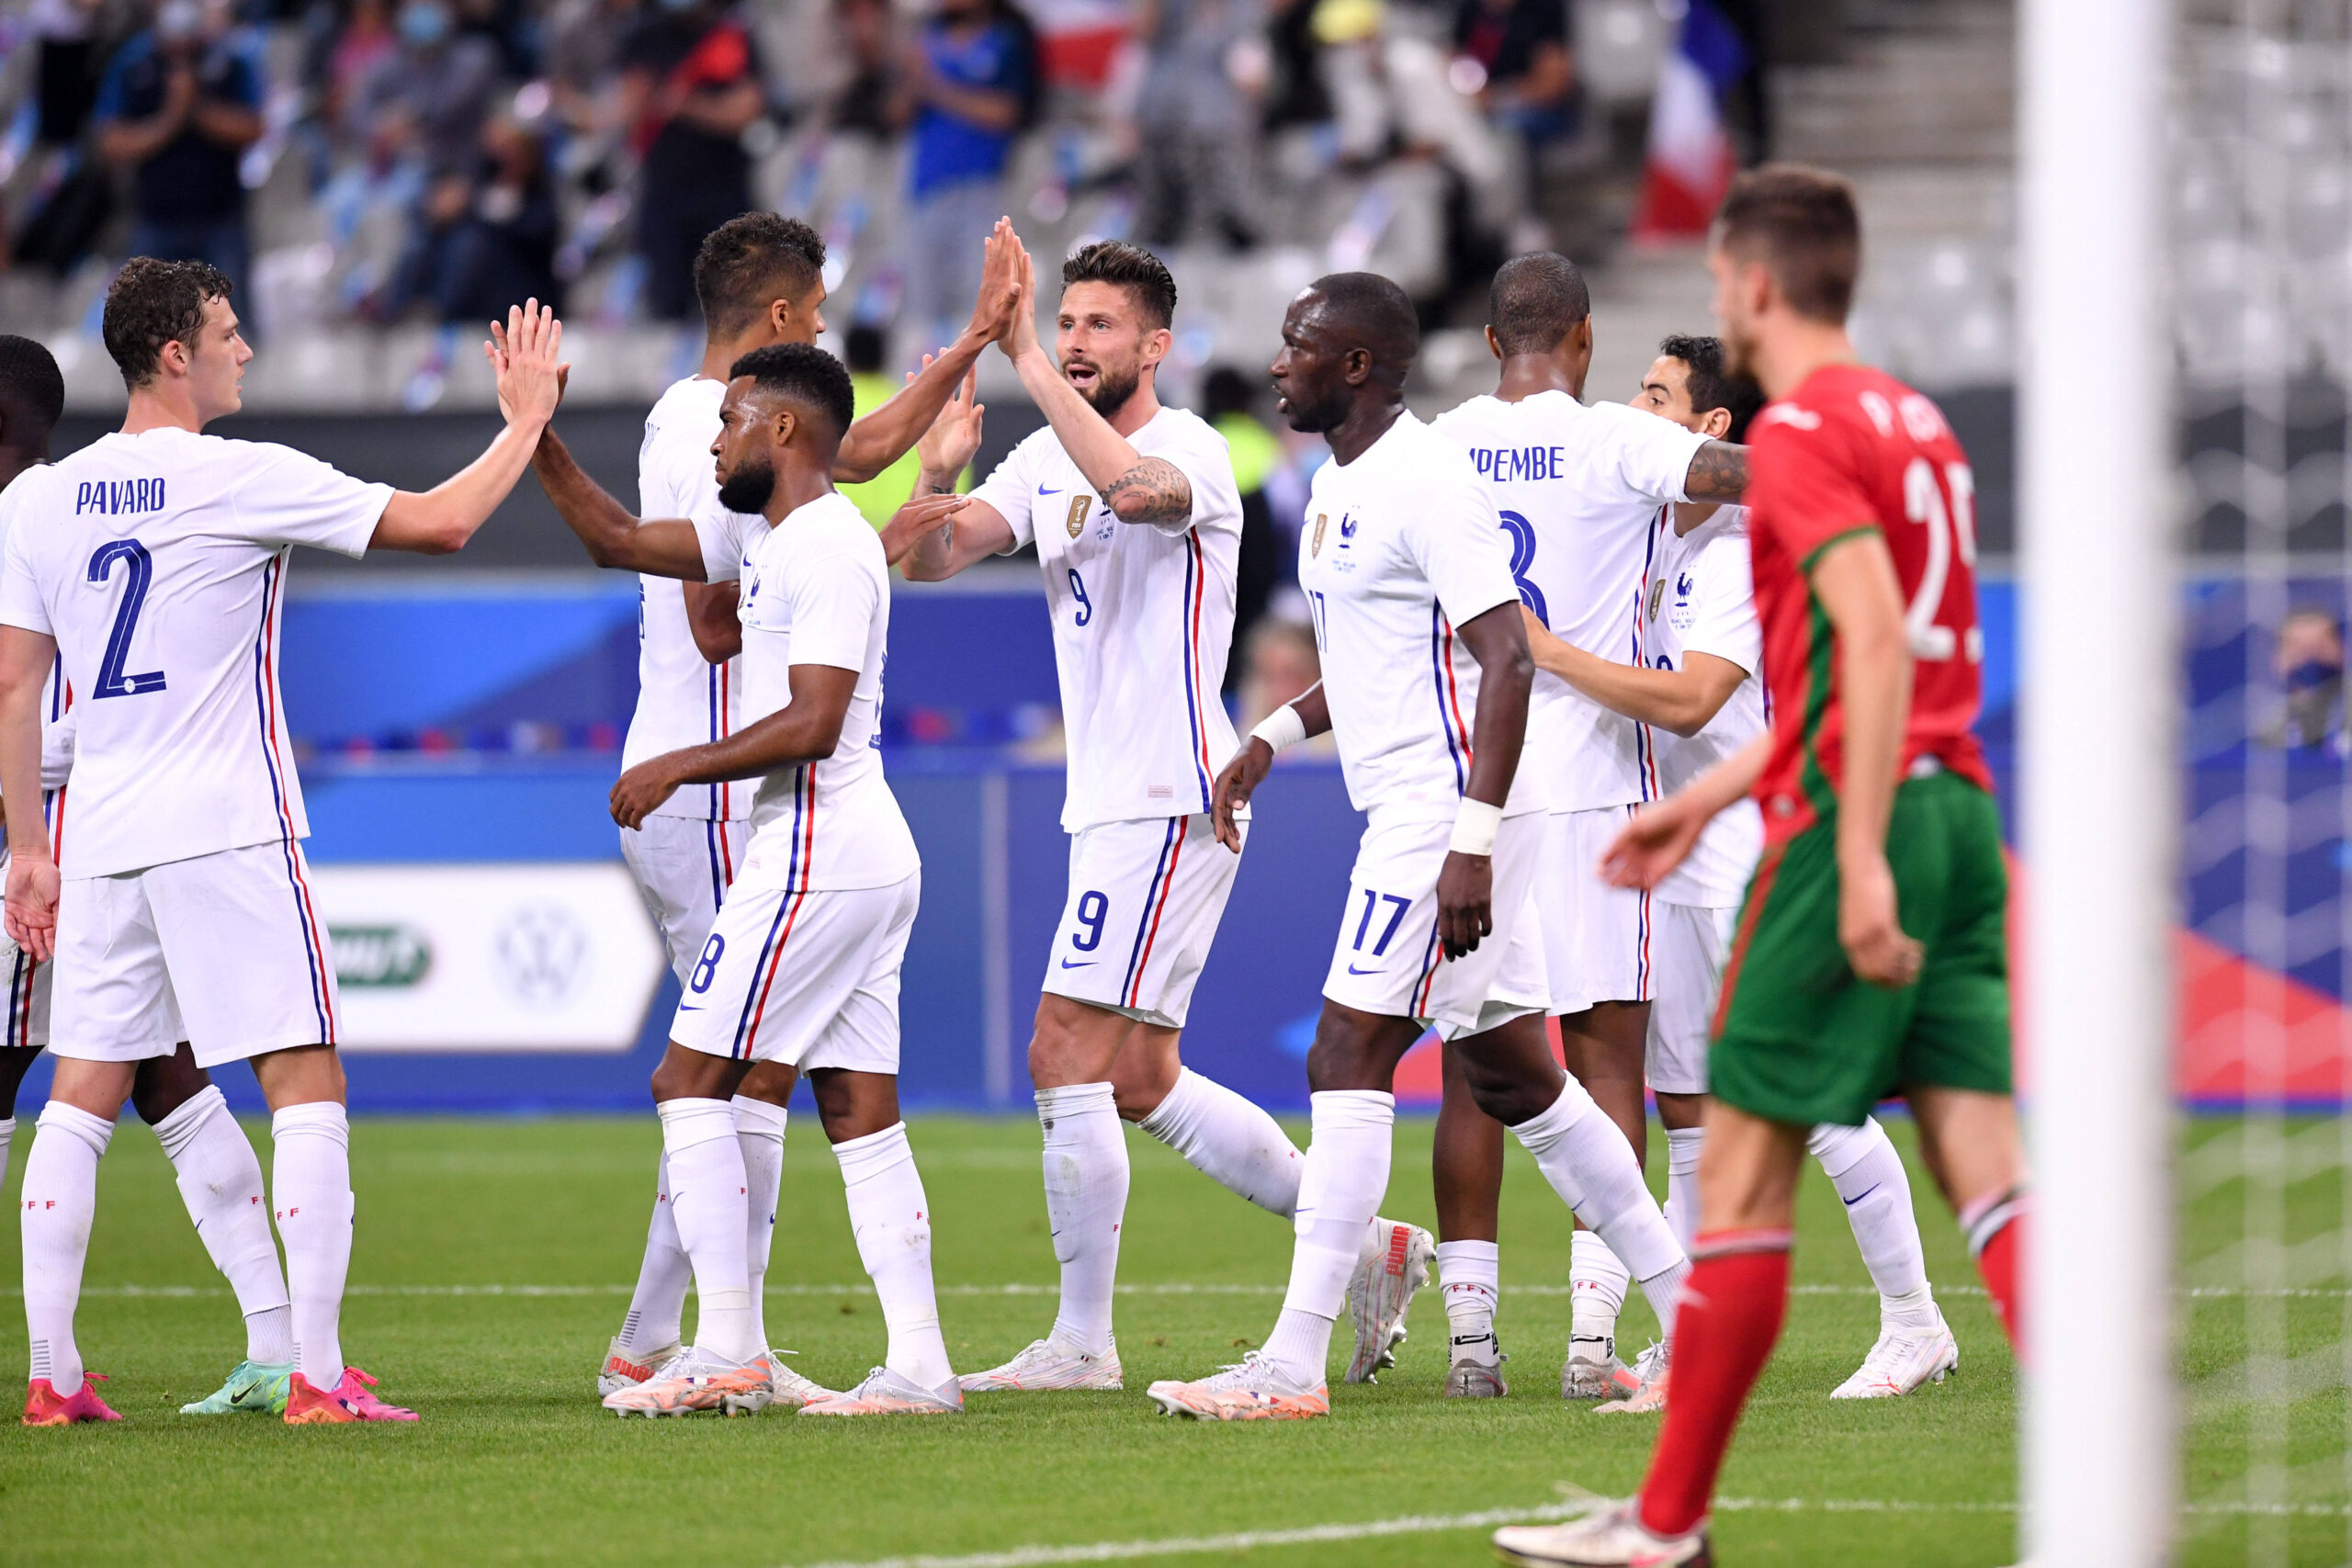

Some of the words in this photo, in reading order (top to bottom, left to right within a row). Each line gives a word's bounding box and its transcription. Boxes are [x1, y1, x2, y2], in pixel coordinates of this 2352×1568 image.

[76, 478, 165, 514] PAVARD
[87, 537, 166, 699] 2
[1069, 569, 1092, 626] 9
[1072, 890, 1109, 952] 9
[1352, 888, 1412, 956] 17
[690, 932, 726, 994] 8
